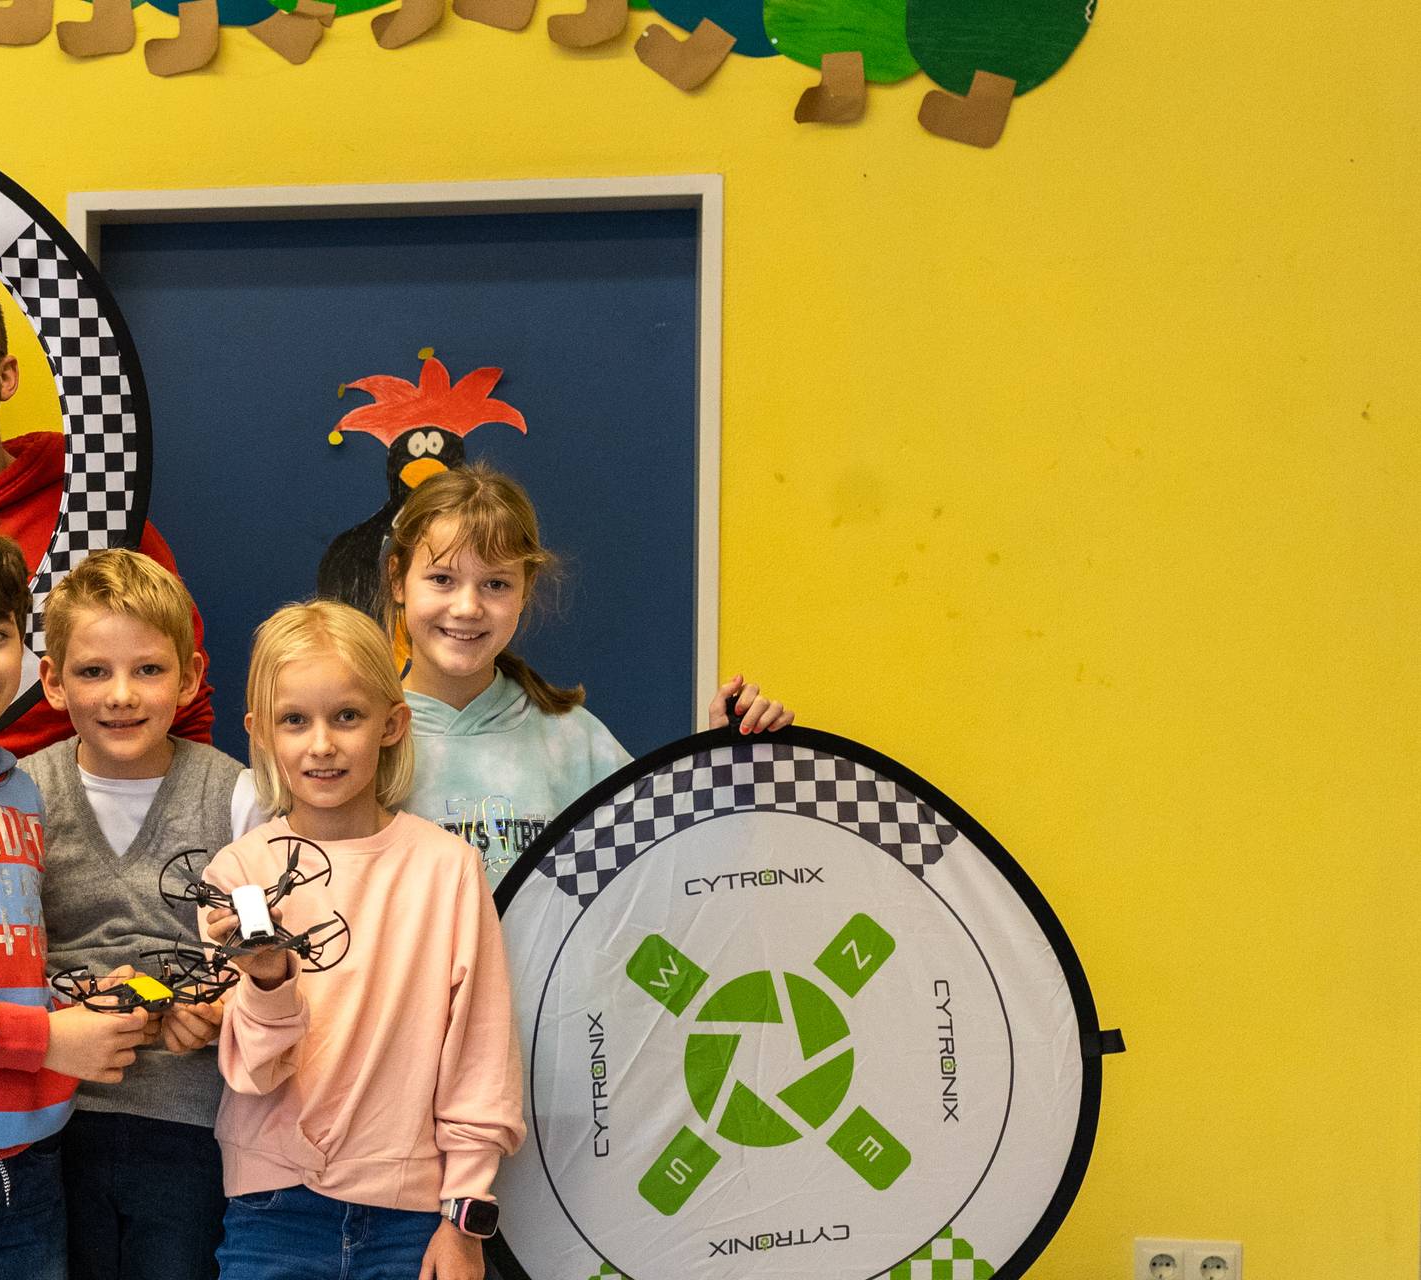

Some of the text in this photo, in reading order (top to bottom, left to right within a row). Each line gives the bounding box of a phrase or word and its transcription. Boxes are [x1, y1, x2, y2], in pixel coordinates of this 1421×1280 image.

[685, 867, 825, 895] CYTRONIX
[649, 955, 680, 989] W
[934, 980, 960, 1123] CYTRONIX
[587, 1011, 610, 1158] CYTRONIX
[857, 1135, 885, 1163] E
[665, 1157, 693, 1186] S
[709, 1224, 851, 1258] CYTRONIX
